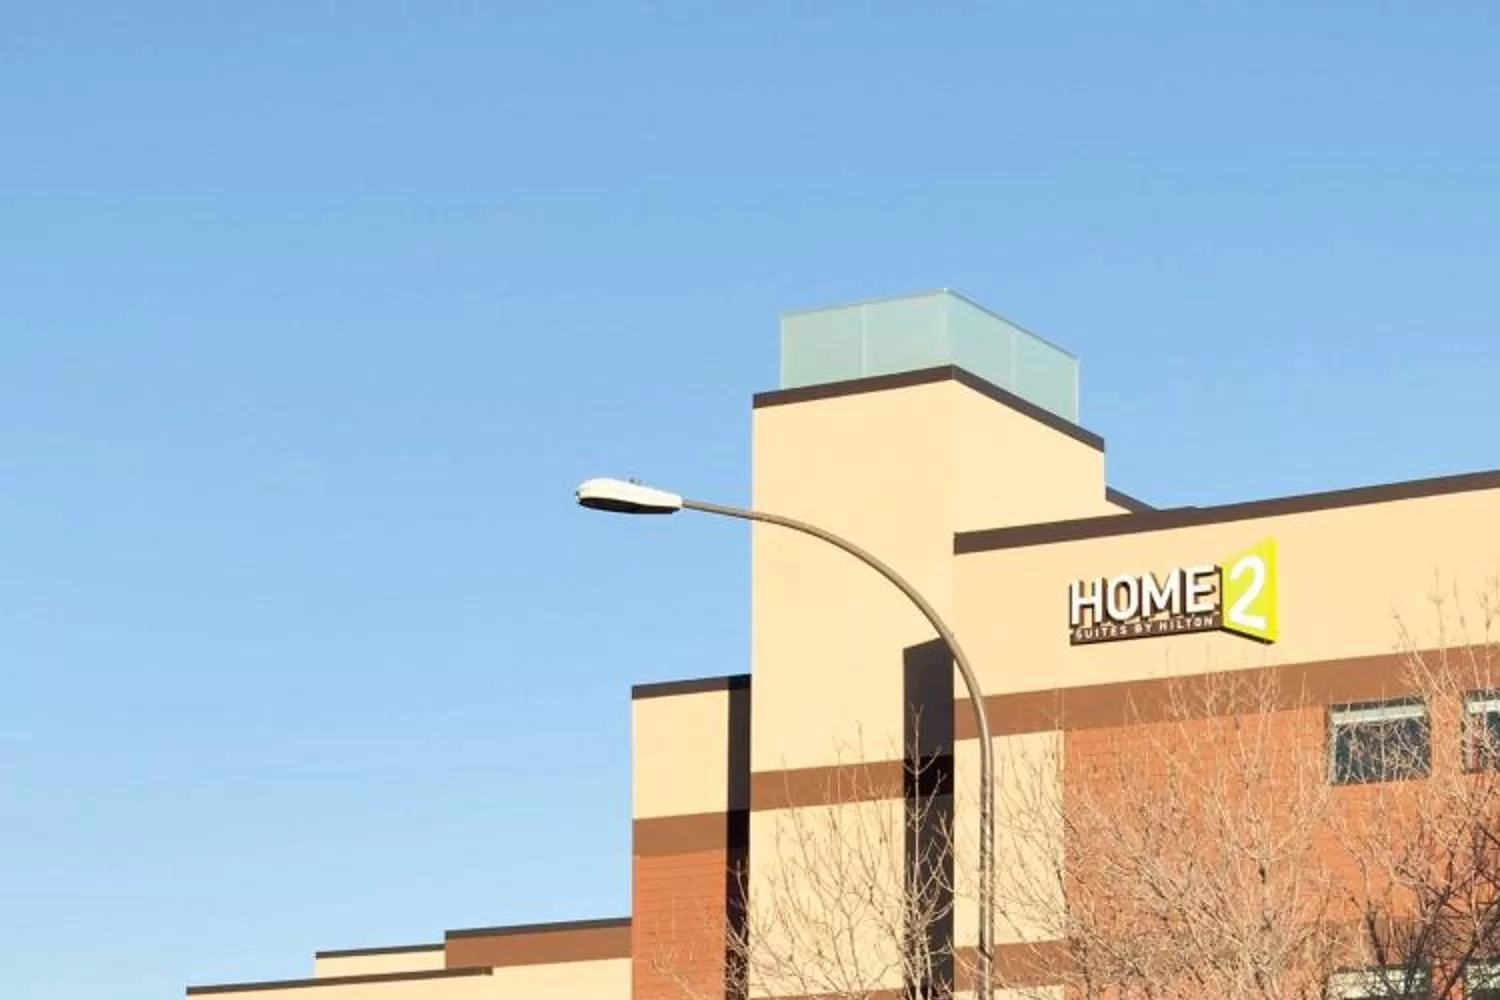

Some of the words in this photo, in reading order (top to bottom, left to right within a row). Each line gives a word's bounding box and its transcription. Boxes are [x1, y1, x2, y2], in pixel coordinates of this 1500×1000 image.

[1070, 564, 1217, 626] HOME
[1229, 554, 1267, 631] 2
[1075, 624, 1129, 641] SUITES
[1134, 622, 1153, 634] BY
[1159, 616, 1213, 631] HILTON
